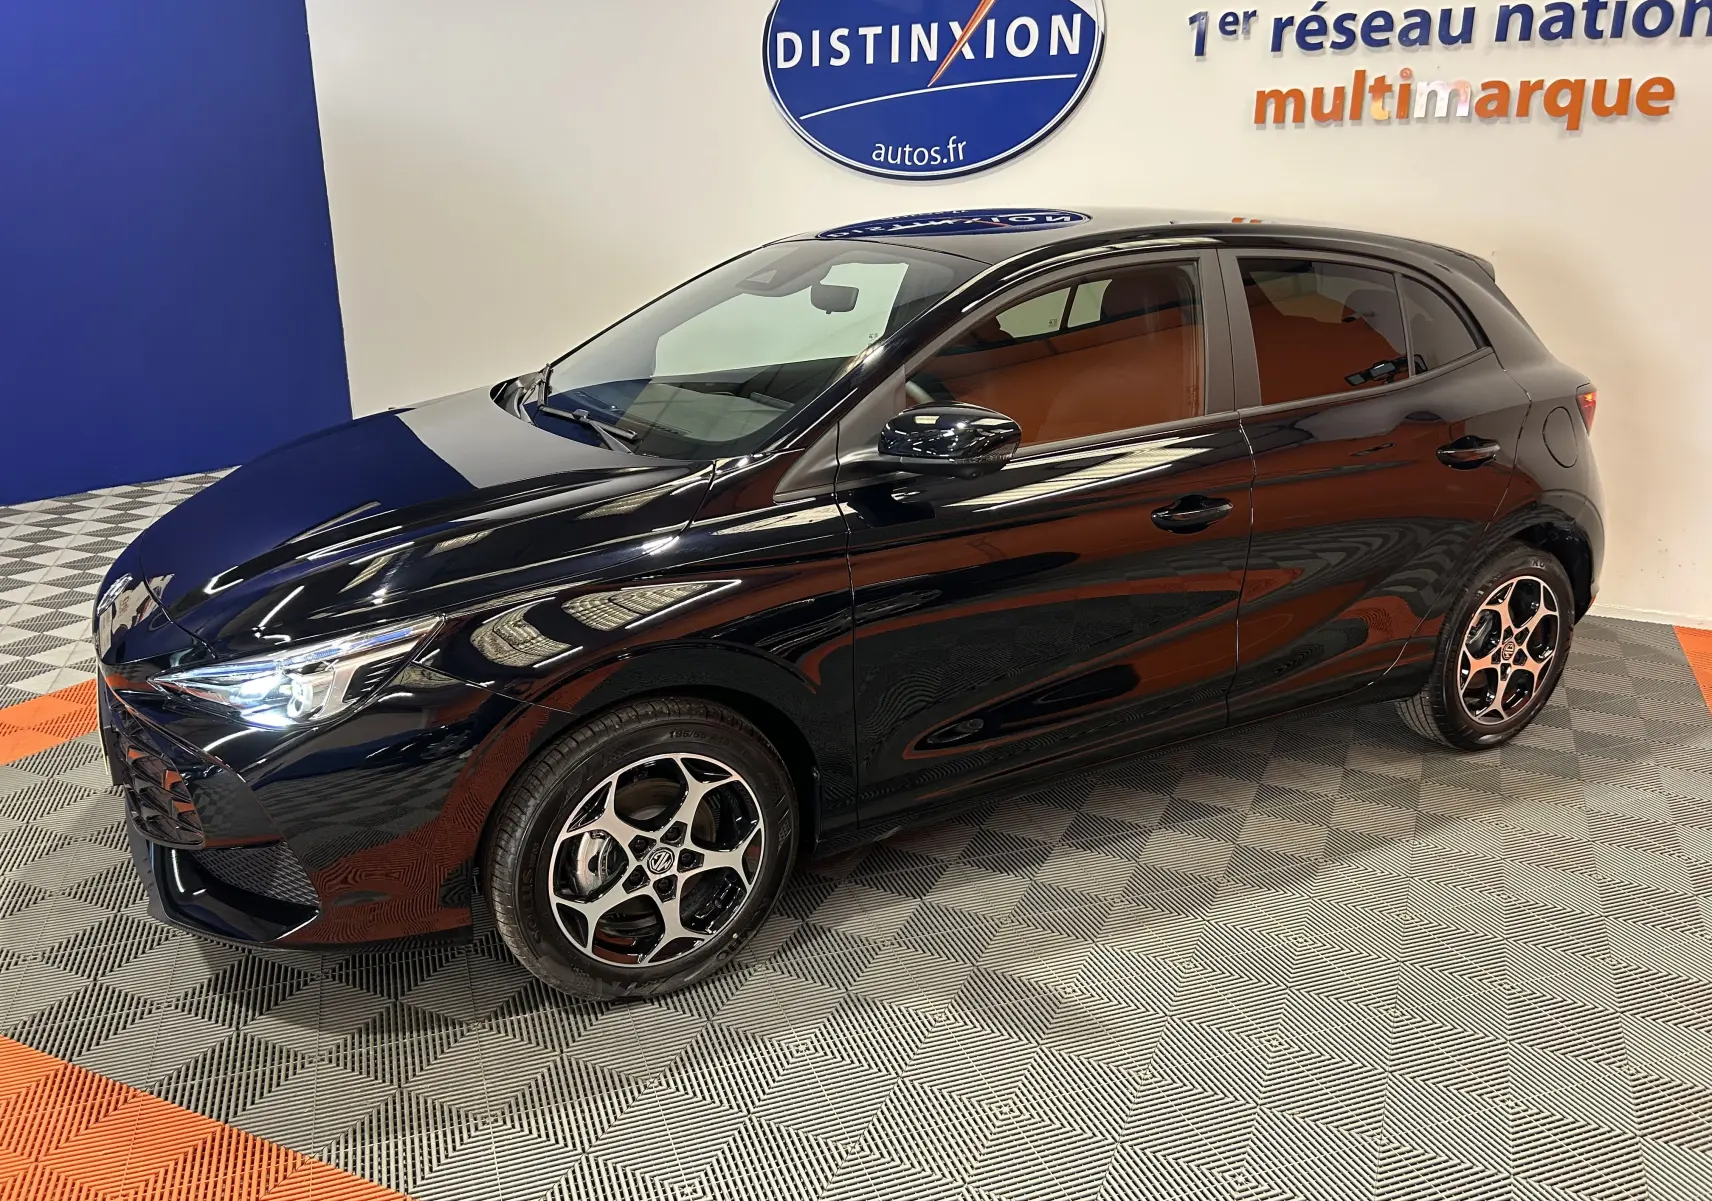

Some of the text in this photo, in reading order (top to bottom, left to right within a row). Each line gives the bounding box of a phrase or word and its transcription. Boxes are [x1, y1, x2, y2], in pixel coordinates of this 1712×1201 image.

[776, 13, 1081, 69] DISTINXION
[1188, 0, 1712, 57] 1er réseau nation
[1253, 68, 1676, 131] multimarque
[871, 136, 966, 167] autos.fr
